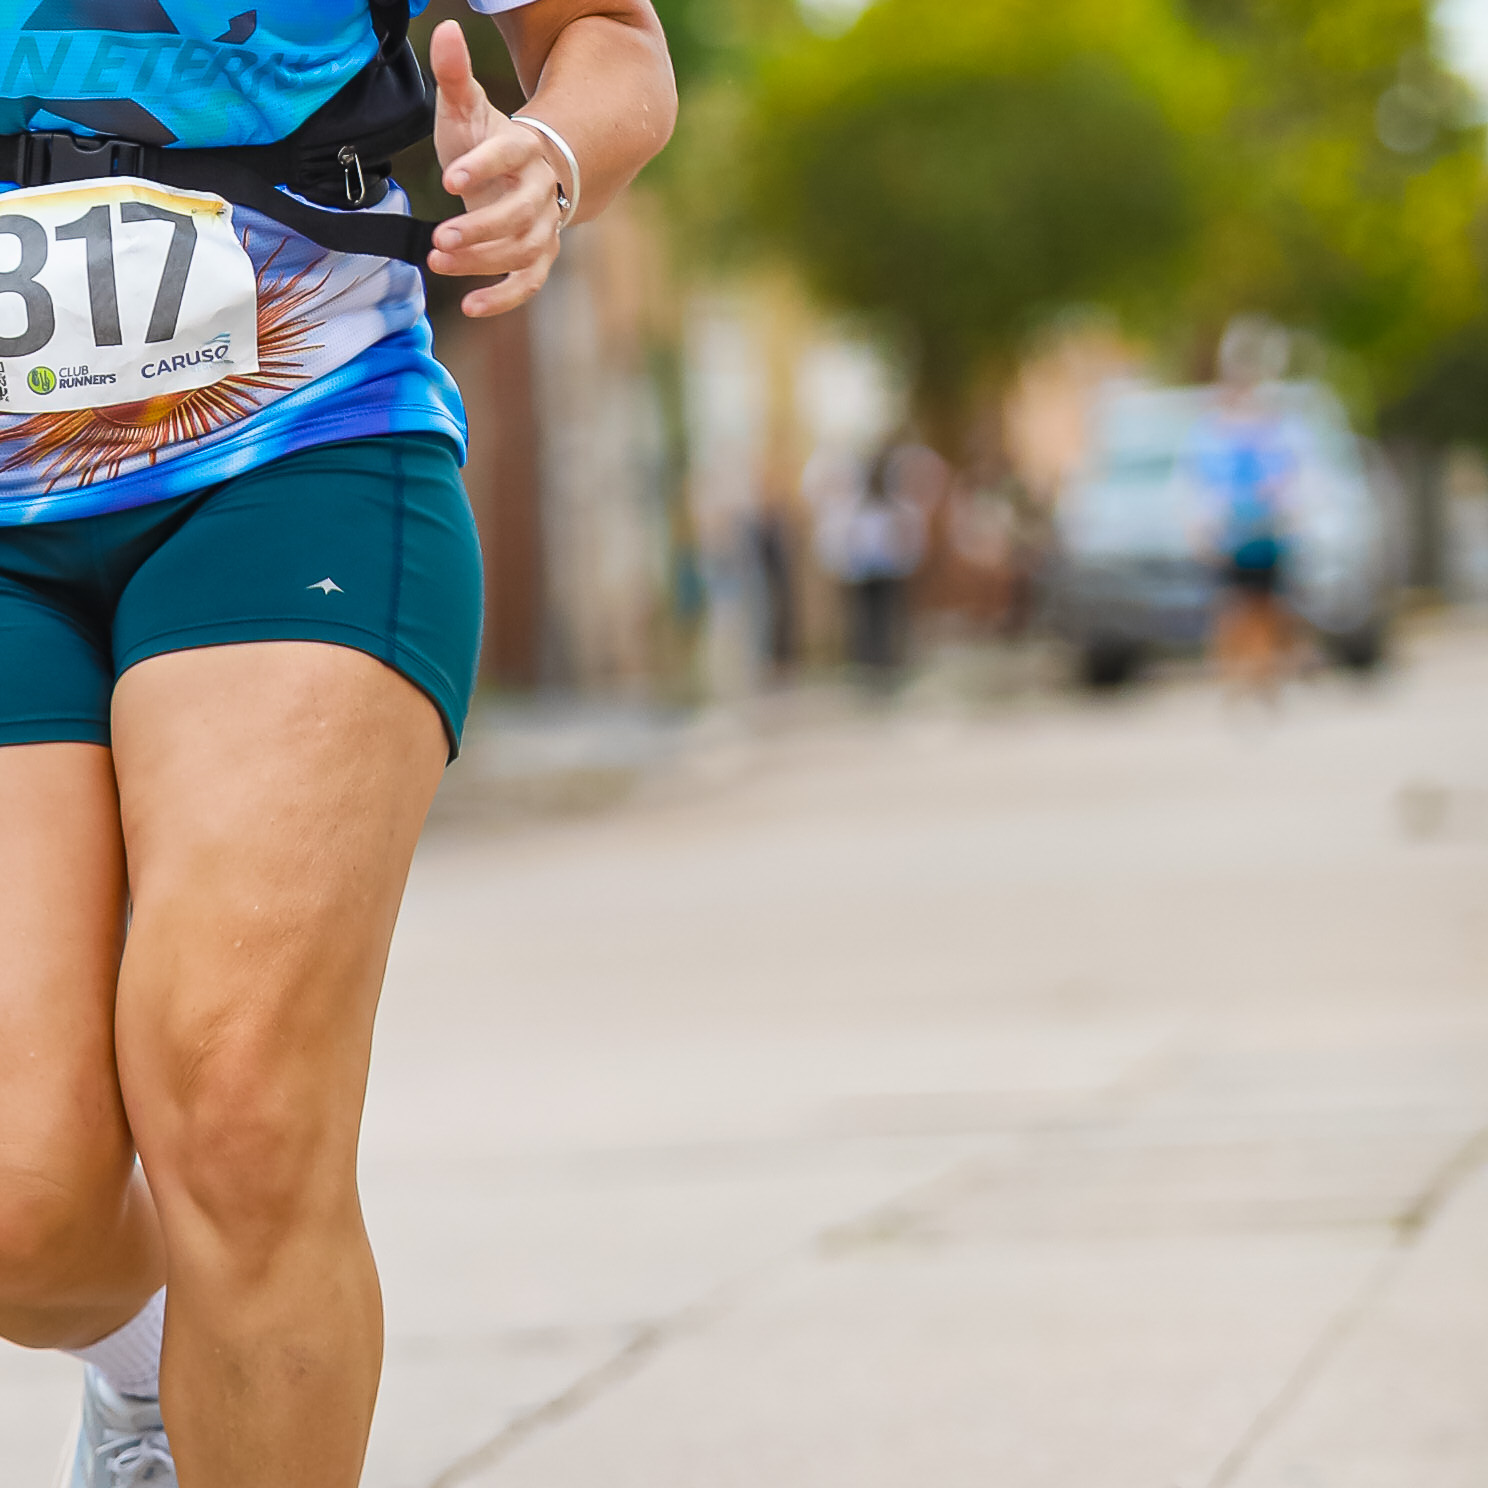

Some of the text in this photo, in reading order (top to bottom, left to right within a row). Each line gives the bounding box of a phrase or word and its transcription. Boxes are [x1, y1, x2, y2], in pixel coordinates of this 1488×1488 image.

[140, 344, 230, 379] CARUSO
[58, 365, 89, 378] CLUB
[58, 373, 117, 390] RUNNER'S
